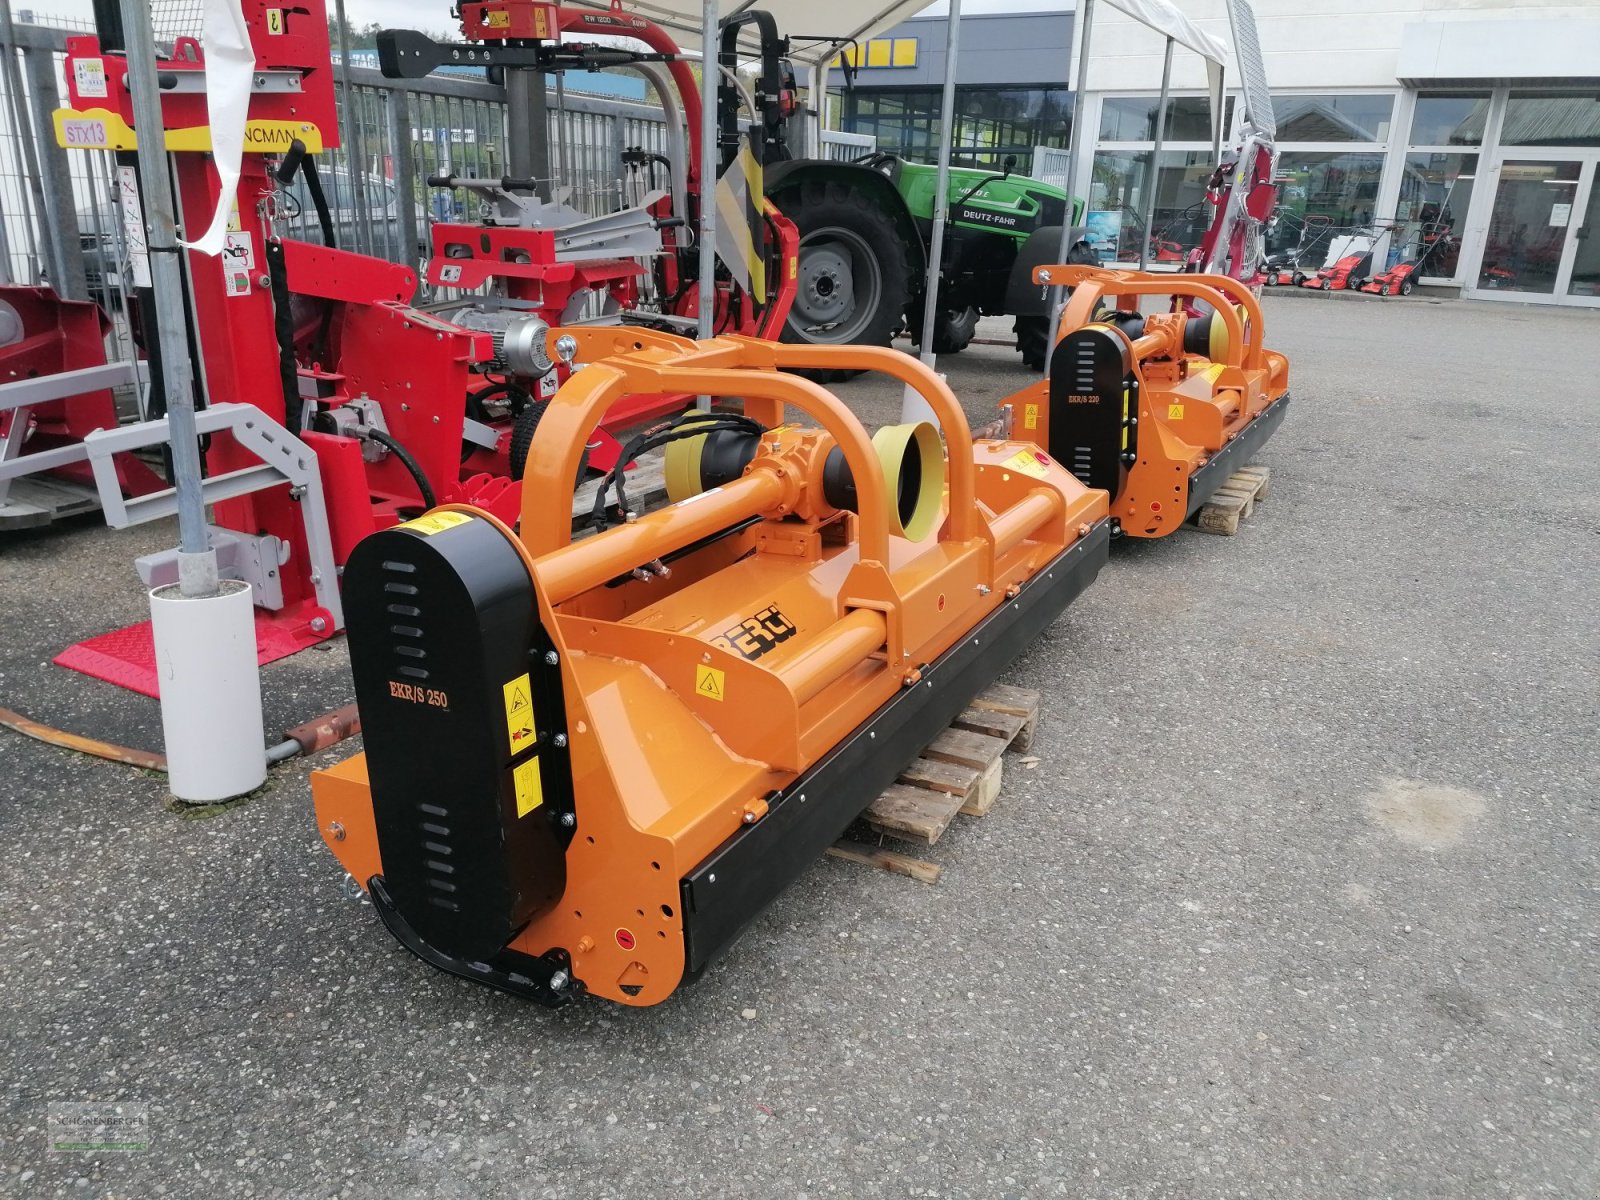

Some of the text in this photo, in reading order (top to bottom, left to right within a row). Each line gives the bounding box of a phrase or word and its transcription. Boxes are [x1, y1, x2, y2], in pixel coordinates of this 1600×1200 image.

[66, 122, 105, 143] STX13
[963, 210, 1016, 225] DEUTZ-FAHR
[1068, 395, 1100, 404] EKR/S 220
[389, 681, 448, 708] EKR/S 250
